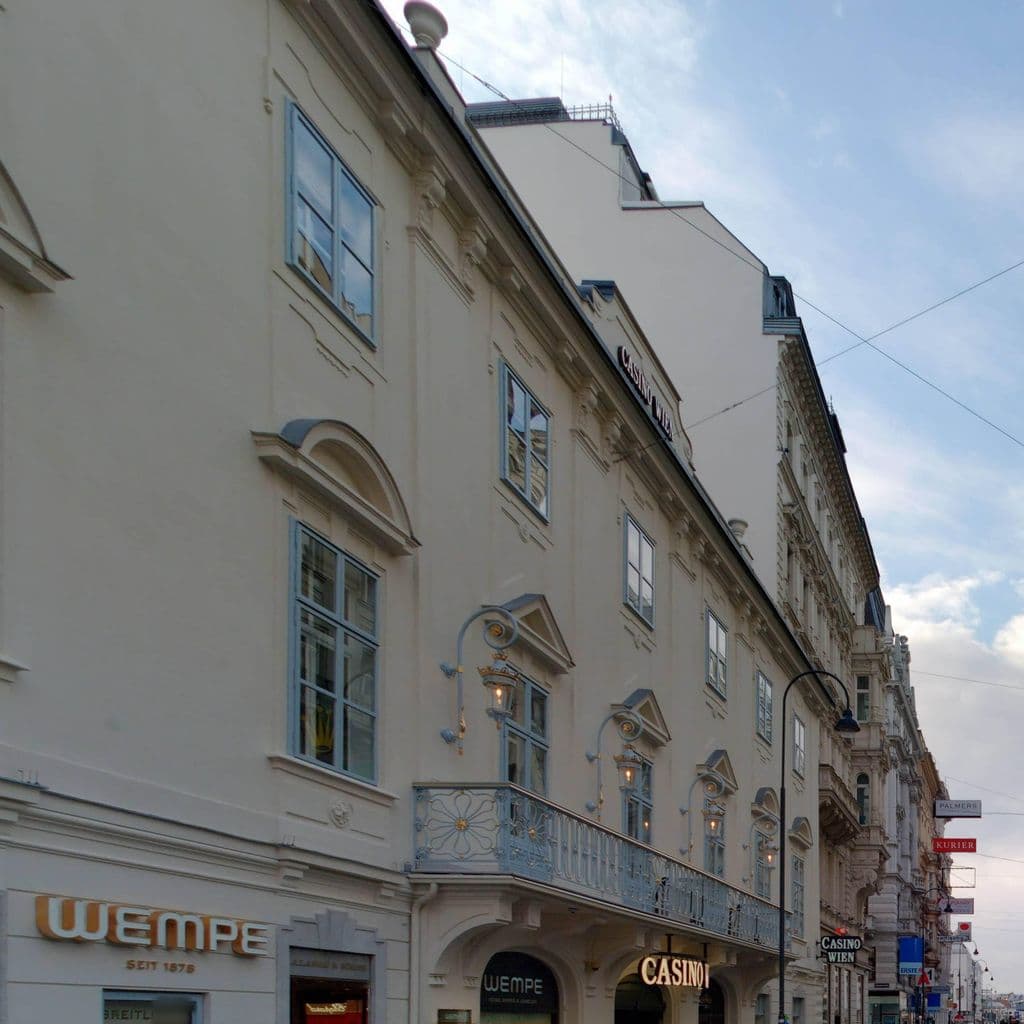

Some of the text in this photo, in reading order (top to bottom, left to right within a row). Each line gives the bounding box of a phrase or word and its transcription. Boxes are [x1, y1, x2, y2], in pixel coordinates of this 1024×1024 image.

[619, 346, 652, 405] CASINO
[939, 802, 978, 810] PALMERS
[936, 841, 975, 849] KURIER
[37, 896, 269, 957] WEMPE
[821, 937, 861, 950] CASINO
[827, 951, 855, 963] WIEN
[126, 960, 195, 973] SEIT 1878
[641, 956, 704, 988] CASINO
[484, 974, 544, 995] WEMPE
